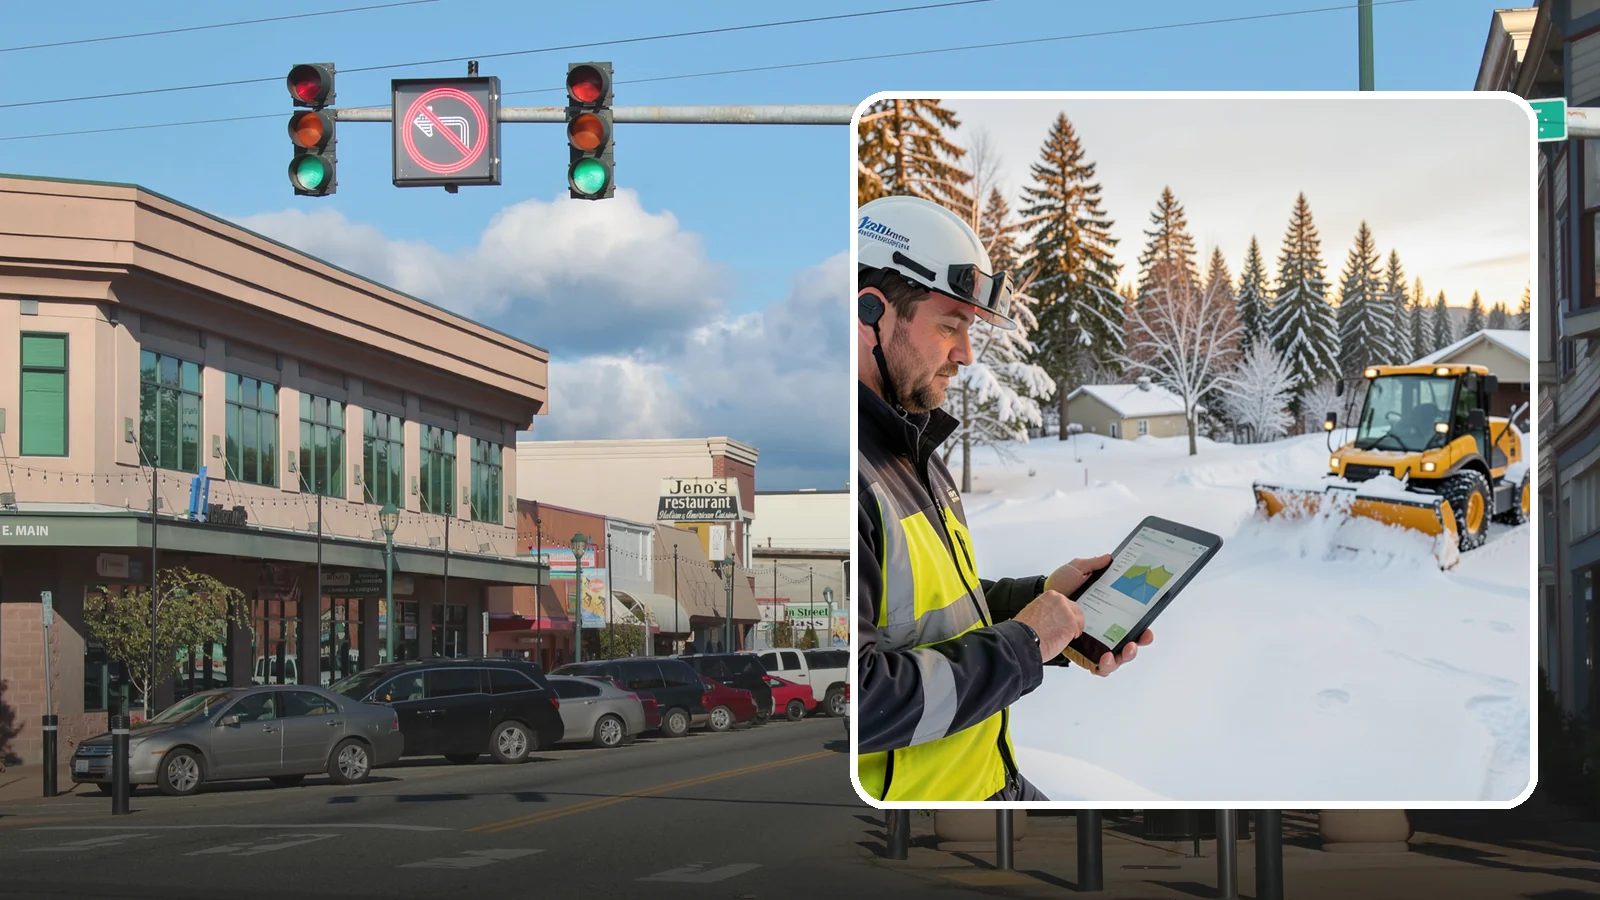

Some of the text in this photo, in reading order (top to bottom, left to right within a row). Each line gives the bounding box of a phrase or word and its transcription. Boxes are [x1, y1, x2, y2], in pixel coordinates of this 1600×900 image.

[670, 480, 727, 494] Jeno's
[665, 496, 731, 509] restaurant
[658, 509, 681, 519] Italian
[686, 509, 714, 519] American
[715, 509, 737, 519] Cuisine
[2, 525, 48, 536] E. MAIN
[797, 607, 828, 616] Street
[791, 619, 823, 627] lass
